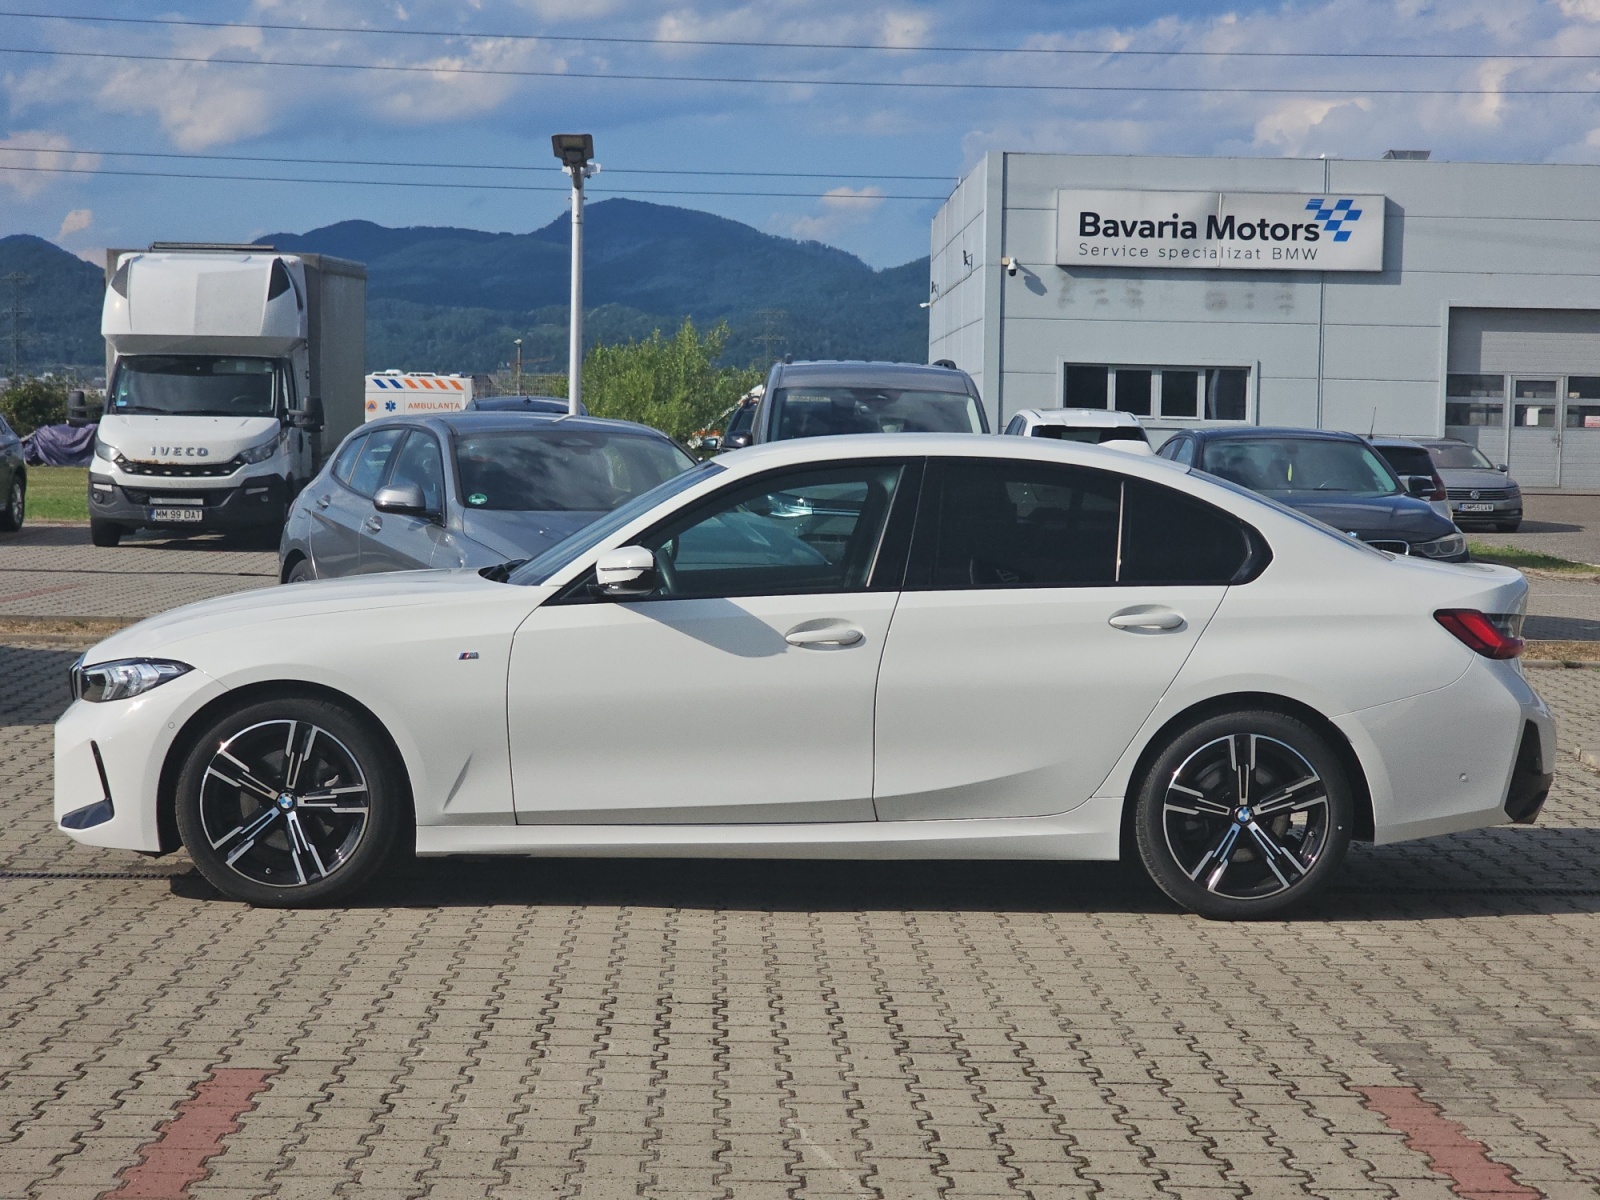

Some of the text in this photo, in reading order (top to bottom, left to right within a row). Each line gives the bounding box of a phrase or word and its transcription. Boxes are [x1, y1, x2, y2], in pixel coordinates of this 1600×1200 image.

[1079, 211, 1320, 242] Bavaria Motors
[1079, 242, 1319, 261] Service specializat BMW
[151, 446, 209, 457] IVECO
[156, 510, 168, 519] MM
[170, 510, 181, 519] 99
